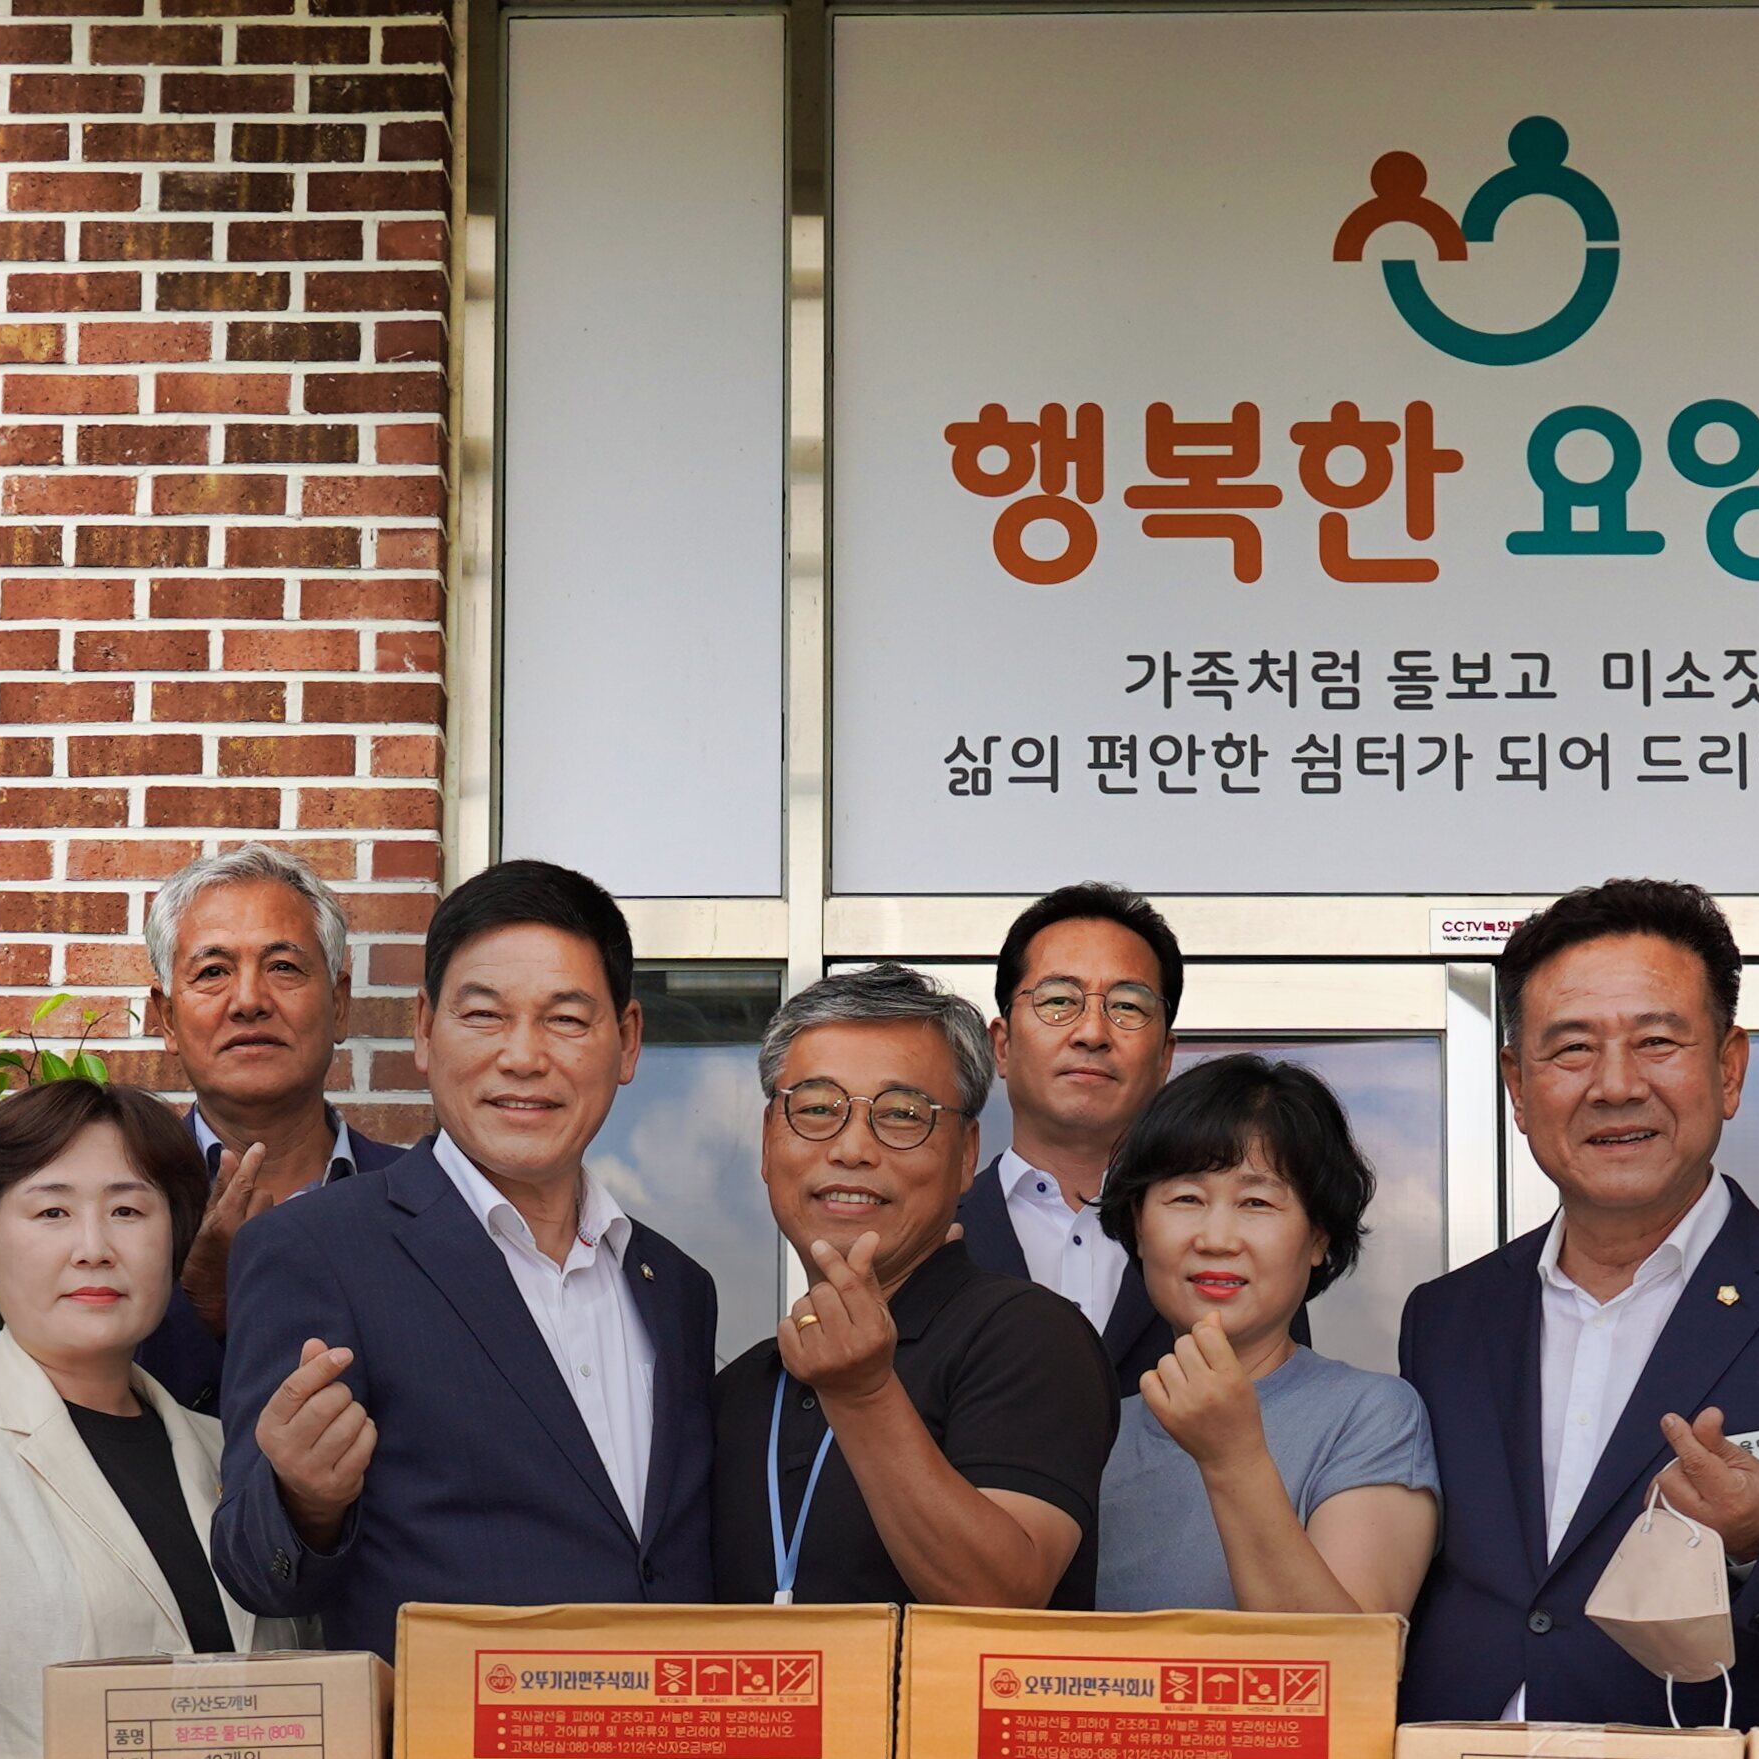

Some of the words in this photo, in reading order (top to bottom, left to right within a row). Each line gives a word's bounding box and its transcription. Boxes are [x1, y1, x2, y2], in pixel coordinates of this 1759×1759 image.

[944, 400, 1463, 585] 행복한
[1124, 649, 1363, 712] 가족처럼
[1386, 649, 1558, 708] 돌보고
[943, 735, 1060, 797] 삶의
[1087, 731, 1268, 795] 편안한
[1291, 731, 1473, 795] 쉼터가
[1497, 731, 1612, 791] 되어
[521, 1670, 649, 1691] 오뚜기라면주식회사
[1024, 1675, 1155, 1698] 오뚜기라면주식회사
[573, 1711, 604, 1724] 피하여
[611, 1711, 655, 1724] 건조하고
[699, 1711, 721, 1724] 곳에
[675, 1726, 721, 1739] 분리하여
